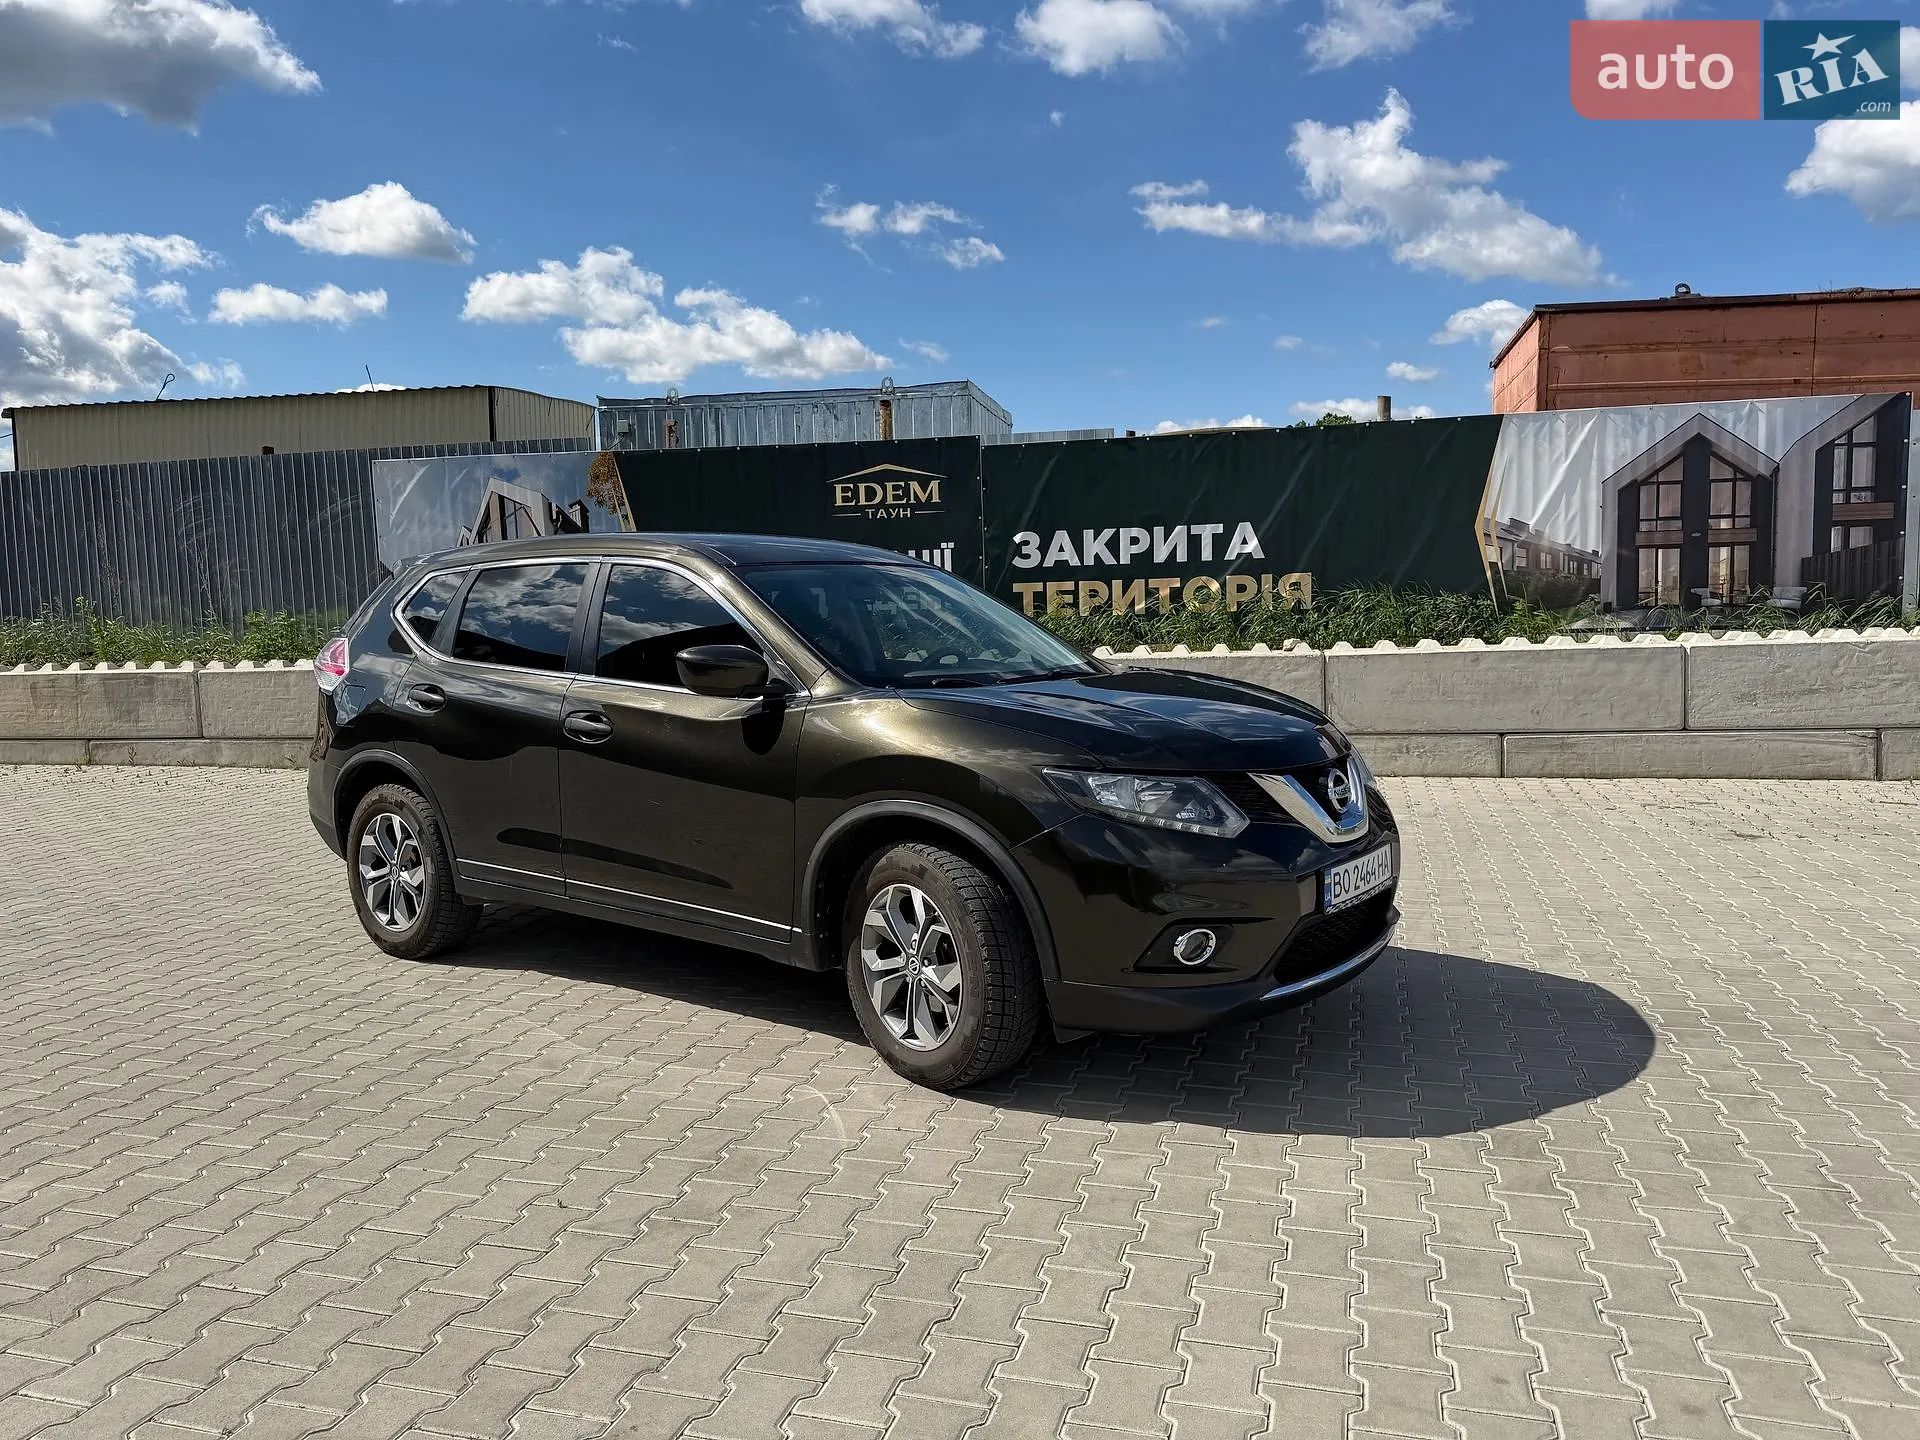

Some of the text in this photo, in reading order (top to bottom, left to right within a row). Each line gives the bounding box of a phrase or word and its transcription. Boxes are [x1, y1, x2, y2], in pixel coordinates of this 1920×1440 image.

[833, 480, 941, 506] EDEM
[865, 507, 911, 519] ТАУН
[1011, 521, 1266, 569] ЗАКРИТА
[1012, 572, 1313, 617] ТЕРИТОРІЯ
[1333, 849, 1390, 899] BO 2464 HA
